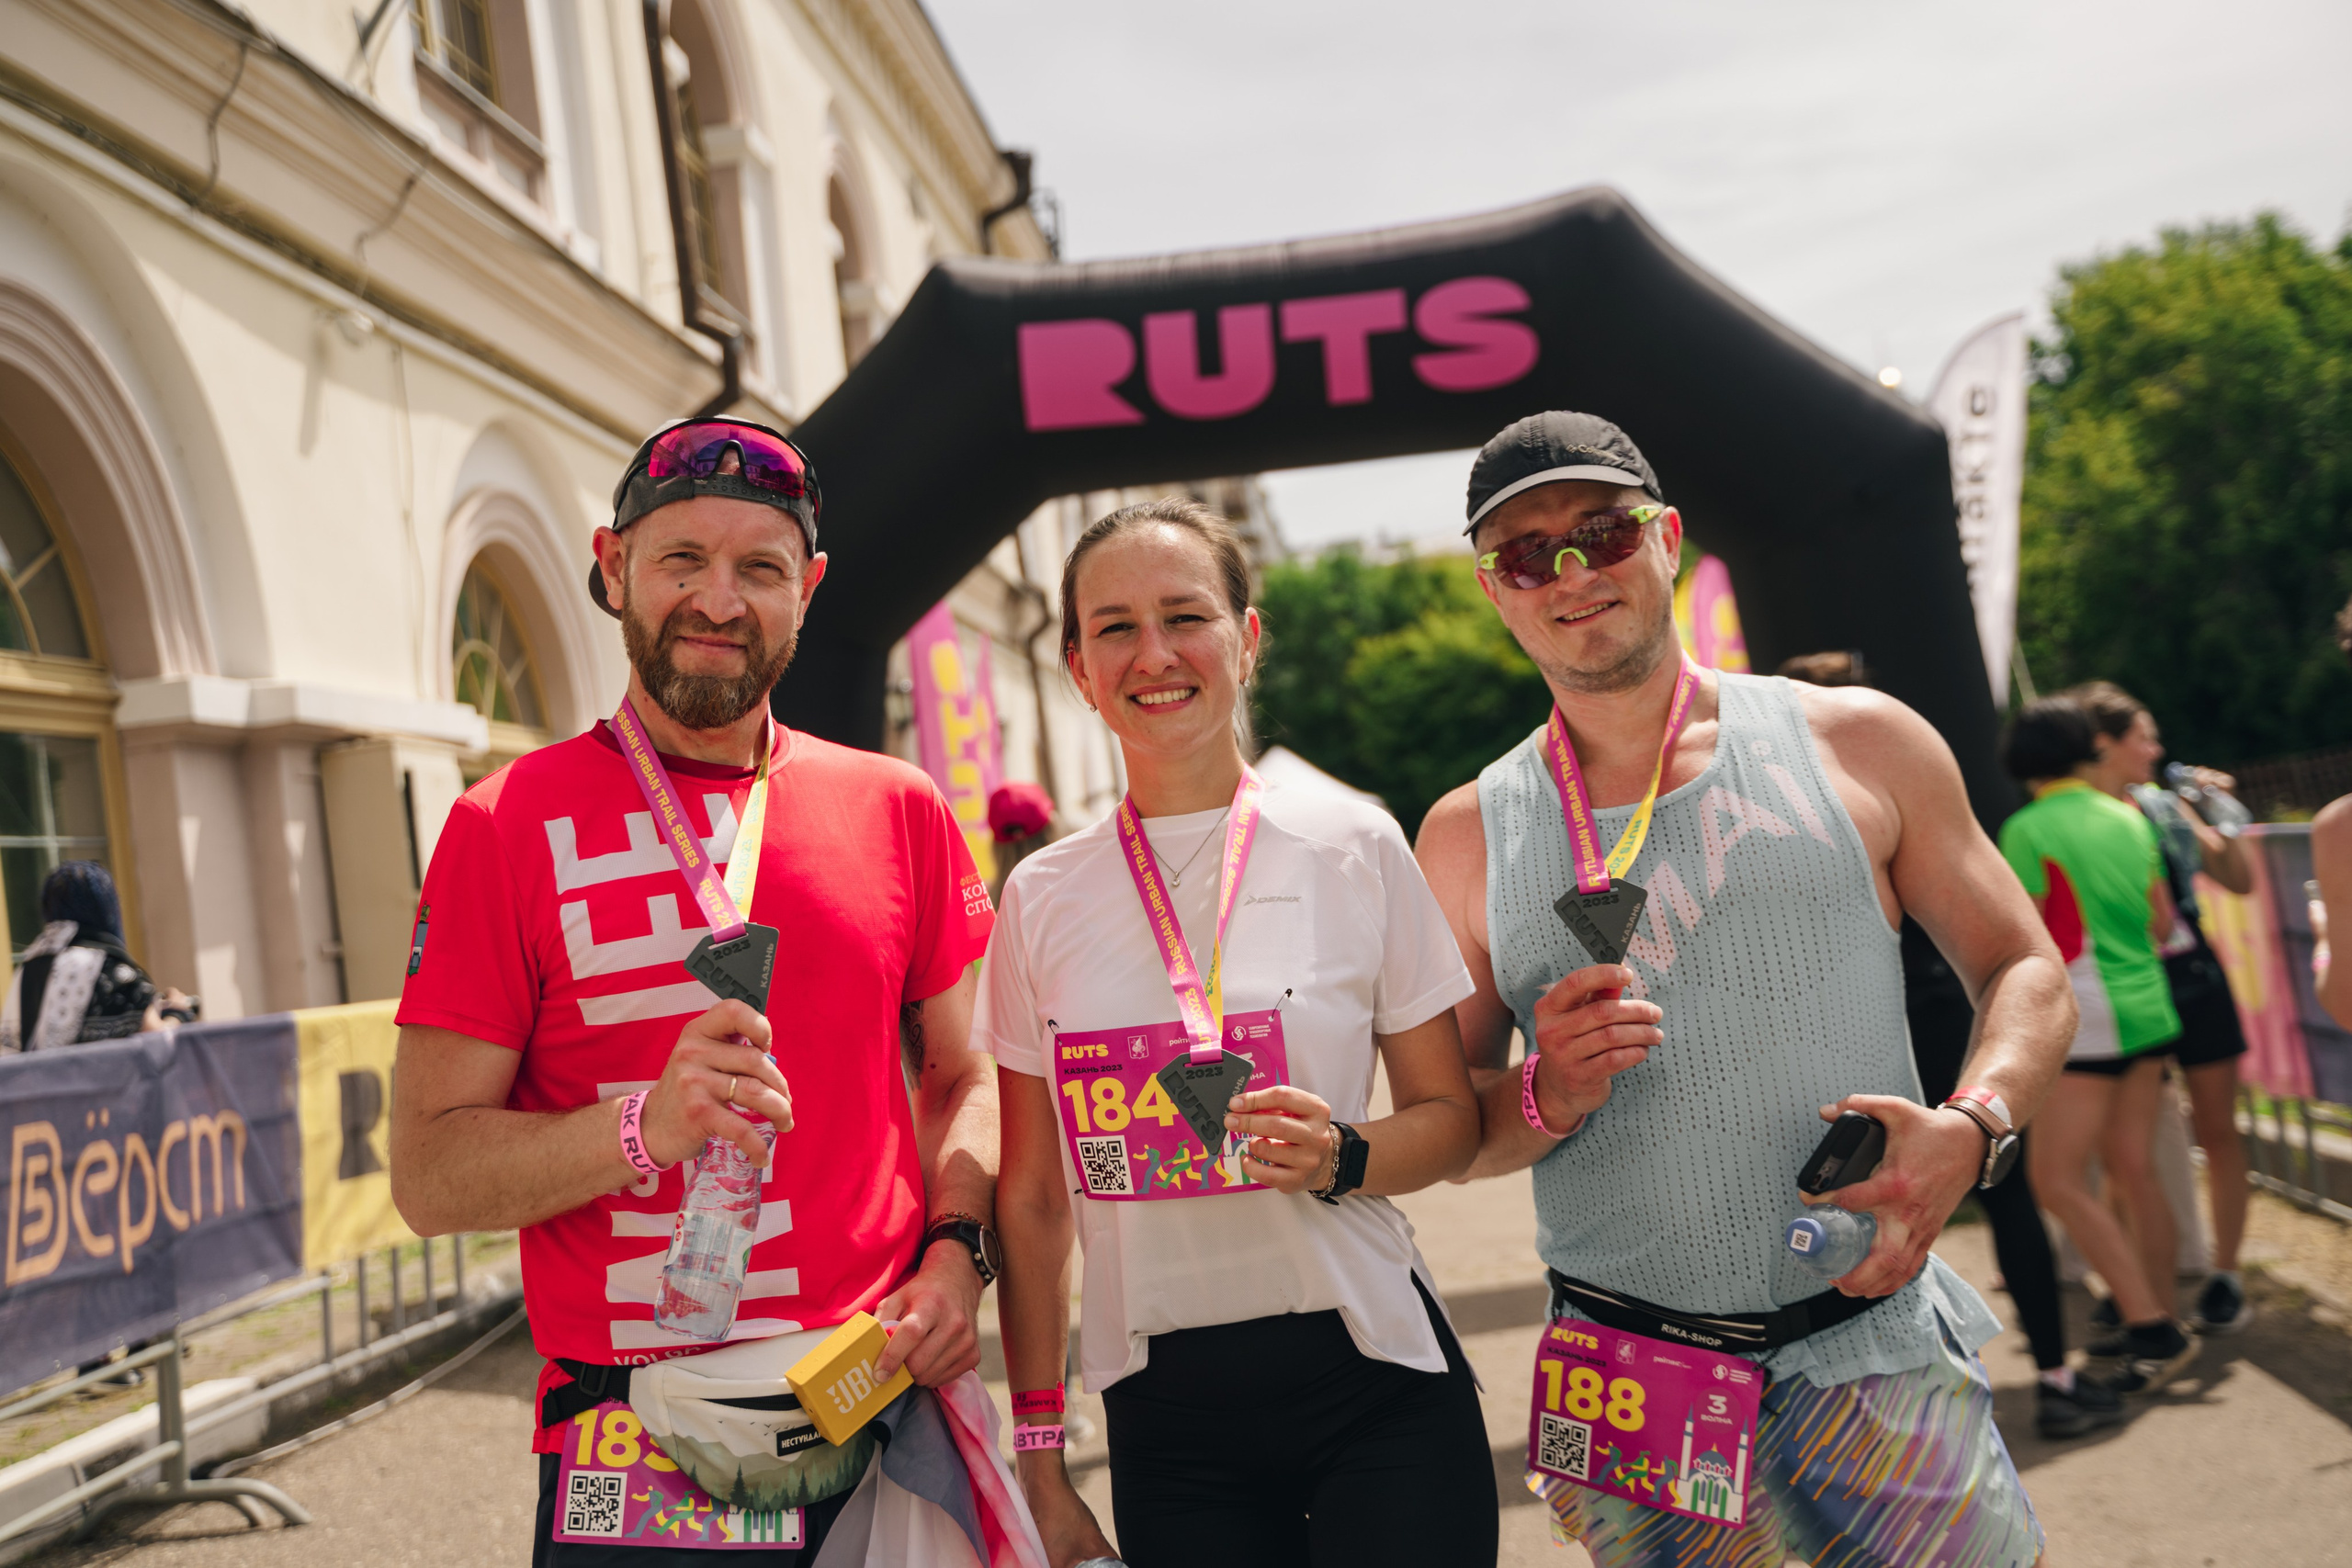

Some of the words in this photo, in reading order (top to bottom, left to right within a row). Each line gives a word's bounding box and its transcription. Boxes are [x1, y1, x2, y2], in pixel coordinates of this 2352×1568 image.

[1017, 276, 1539, 431] RUTS
[1555, 741, 1575, 782] TRAIL
[635, 747, 662, 791] URBAN
[655, 788, 678, 826] TRAIL
[671, 824, 699, 868] SERIES
[1119, 800, 1136, 837] SERIE
[1238, 782, 1258, 826] URBAN
[1566, 780, 1587, 830] URBAN
[739, 838, 753, 868] 2023
[1130, 836, 1148, 874] TRAIL
[1229, 827, 1247, 864] TRAIL
[1619, 819, 1644, 854] RUTS
[699, 878, 724, 912] RUTS
[732, 869, 748, 905] RUTS
[1142, 871, 1166, 919] URBAN
[1220, 865, 1237, 919] SERIES
[1582, 894, 1620, 908] 2023
[1561, 900, 1619, 964] RUTS
[1621, 903, 1642, 943] КАЗАНЬ
[713, 939, 752, 961] 2023
[1159, 916, 1188, 976] RUSSIAN
[761, 943, 774, 987] КАЗАНЬ
[1185, 987, 1204, 1021] 2023
[1061, 1043, 1109, 1060] RUTS
[1101, 1064, 1123, 1072] 2023
[1185, 1066, 1224, 1080] 2023
[1061, 1072, 1180, 1133] 184
[1163, 1070, 1221, 1141] RUTS
[624, 1136, 660, 1174] RUT
[1550, 1326, 1599, 1350] RUTS
[1660, 1323, 1724, 1348] RIKA-SHOP
[1546, 1346, 1584, 1361] КАЗАНЬ
[1585, 1356, 1607, 1368] 2023
[1540, 1359, 1646, 1432] 188
[1707, 1393, 1728, 1415] 3
